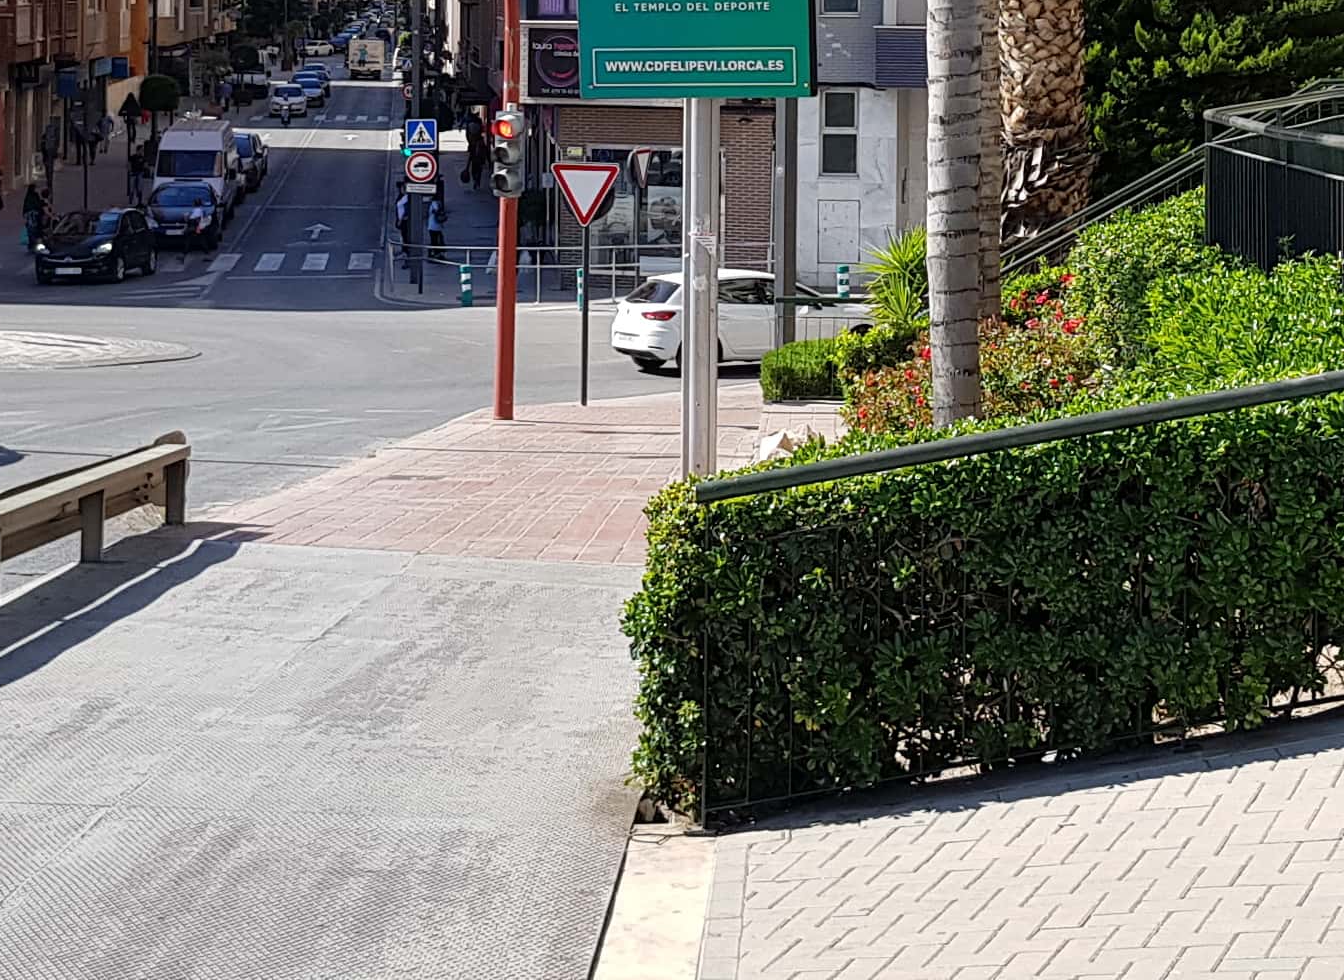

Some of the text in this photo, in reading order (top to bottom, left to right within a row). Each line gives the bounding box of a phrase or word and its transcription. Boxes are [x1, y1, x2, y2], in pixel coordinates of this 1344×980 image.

[615, 1, 770, 12] EL TEMPLO DEL DEPORTE
[605, 60, 784, 72] WWW.CDFELIPEVI.LORCA.ES
